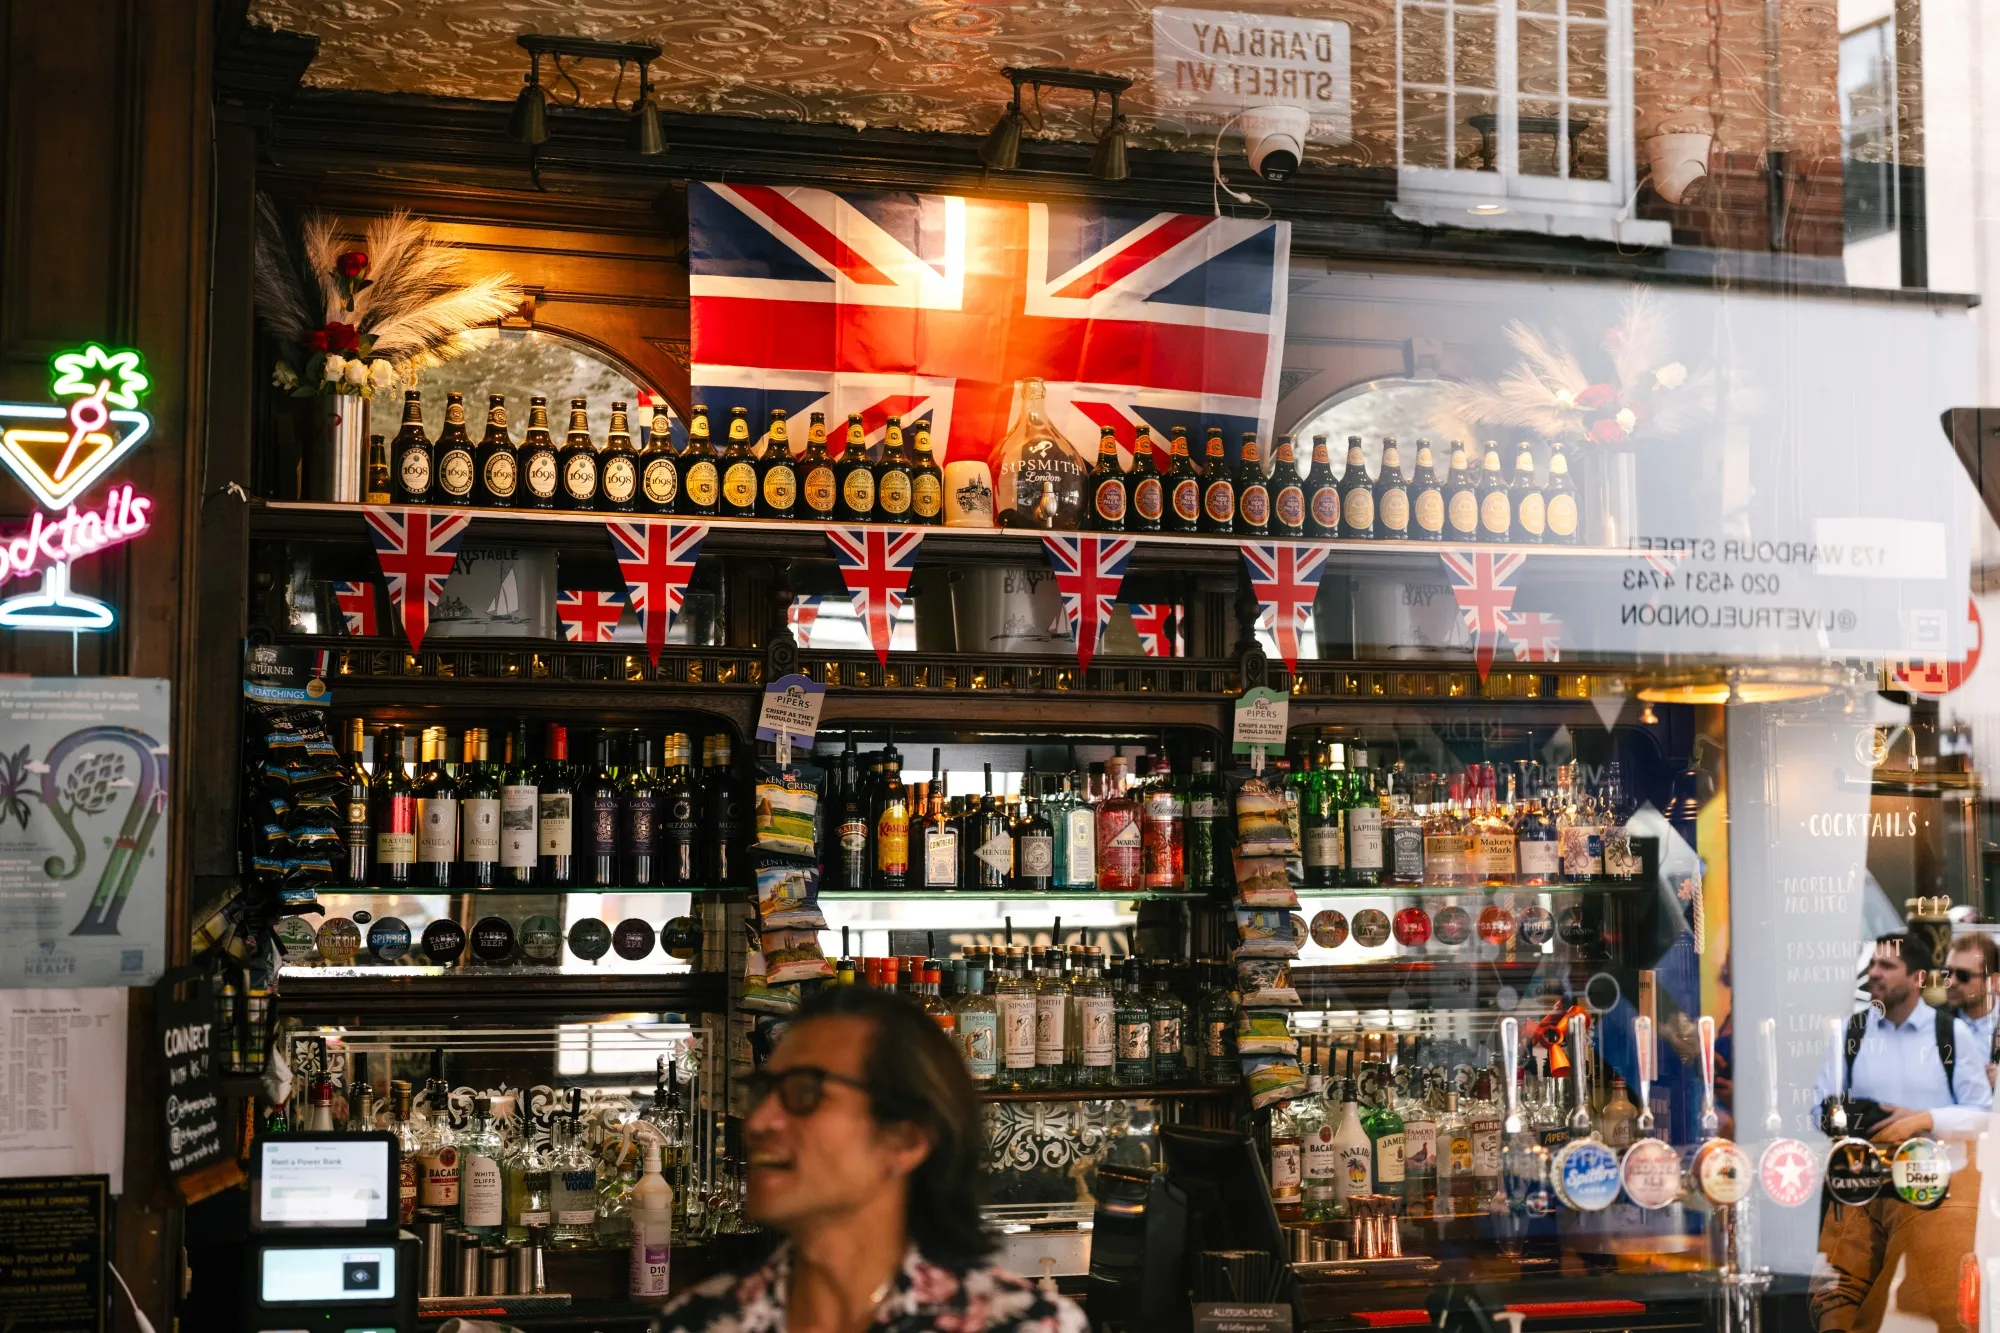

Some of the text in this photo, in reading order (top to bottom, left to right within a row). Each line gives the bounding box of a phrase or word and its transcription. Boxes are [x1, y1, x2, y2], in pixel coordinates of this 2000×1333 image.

[403, 463, 427, 478] 1698
[447, 467, 468, 479] 1698
[1001, 459, 1081, 476] SIPSMITH
[493, 469, 513, 480] 1698
[531, 466, 555, 483] 1698
[569, 469, 594, 483] 1698
[607, 472, 632, 486] 1698
[1025, 470, 1061, 482] London
[652, 476, 672, 486] 1698
[1003, 577, 1039, 595] BAY
[1402, 593, 1434, 607] BAY
[776, 695, 810, 709] PIPERS
[765, 707, 787, 716] CRISPS
[798, 713, 815, 721] THEY
[1246, 709, 1277, 719] PIPERS
[765, 714, 792, 723] SHOULD
[793, 719, 813, 727] TASTE
[765, 775, 786, 787] KENT
[787, 782, 817, 791] CRISPS
[420, 836, 451, 845] AÑUELA
[470, 837, 499, 846] AÑUELA
[1784, 876, 1855, 894] MORELLA
[1785, 894, 1951, 916] MOJITO £12
[1403, 923, 1424, 932] XPA
[319, 935, 357, 948] NECK OIL
[371, 933, 408, 944] SPITFIRE
[478, 932, 508, 941] TABLE
[522, 937, 540, 945] BAY
[432, 942, 457, 951] BEER
[480, 939, 504, 947] BEER
[1788, 938, 1904, 960] PASSIONFUIT
[24, 964, 76, 974] NEAME
[1918, 970, 1952, 989] £13
[164, 1024, 212, 1058] CONNECT
[170, 1066, 187, 1087] WITH
[271, 1158, 289, 1166] Rent
[298, 1158, 321, 1166] Power
[1566, 1166, 1618, 1188] Spitfire
[1831, 1177, 1881, 1189] GUINNESS
[17, 1253, 49, 1264] Proof
[52, 1253, 65, 1262] of
[67, 1252, 91, 1263] Age
[12, 1267, 76, 1278] No Alcohol
[649, 1266, 666, 1274] D10
